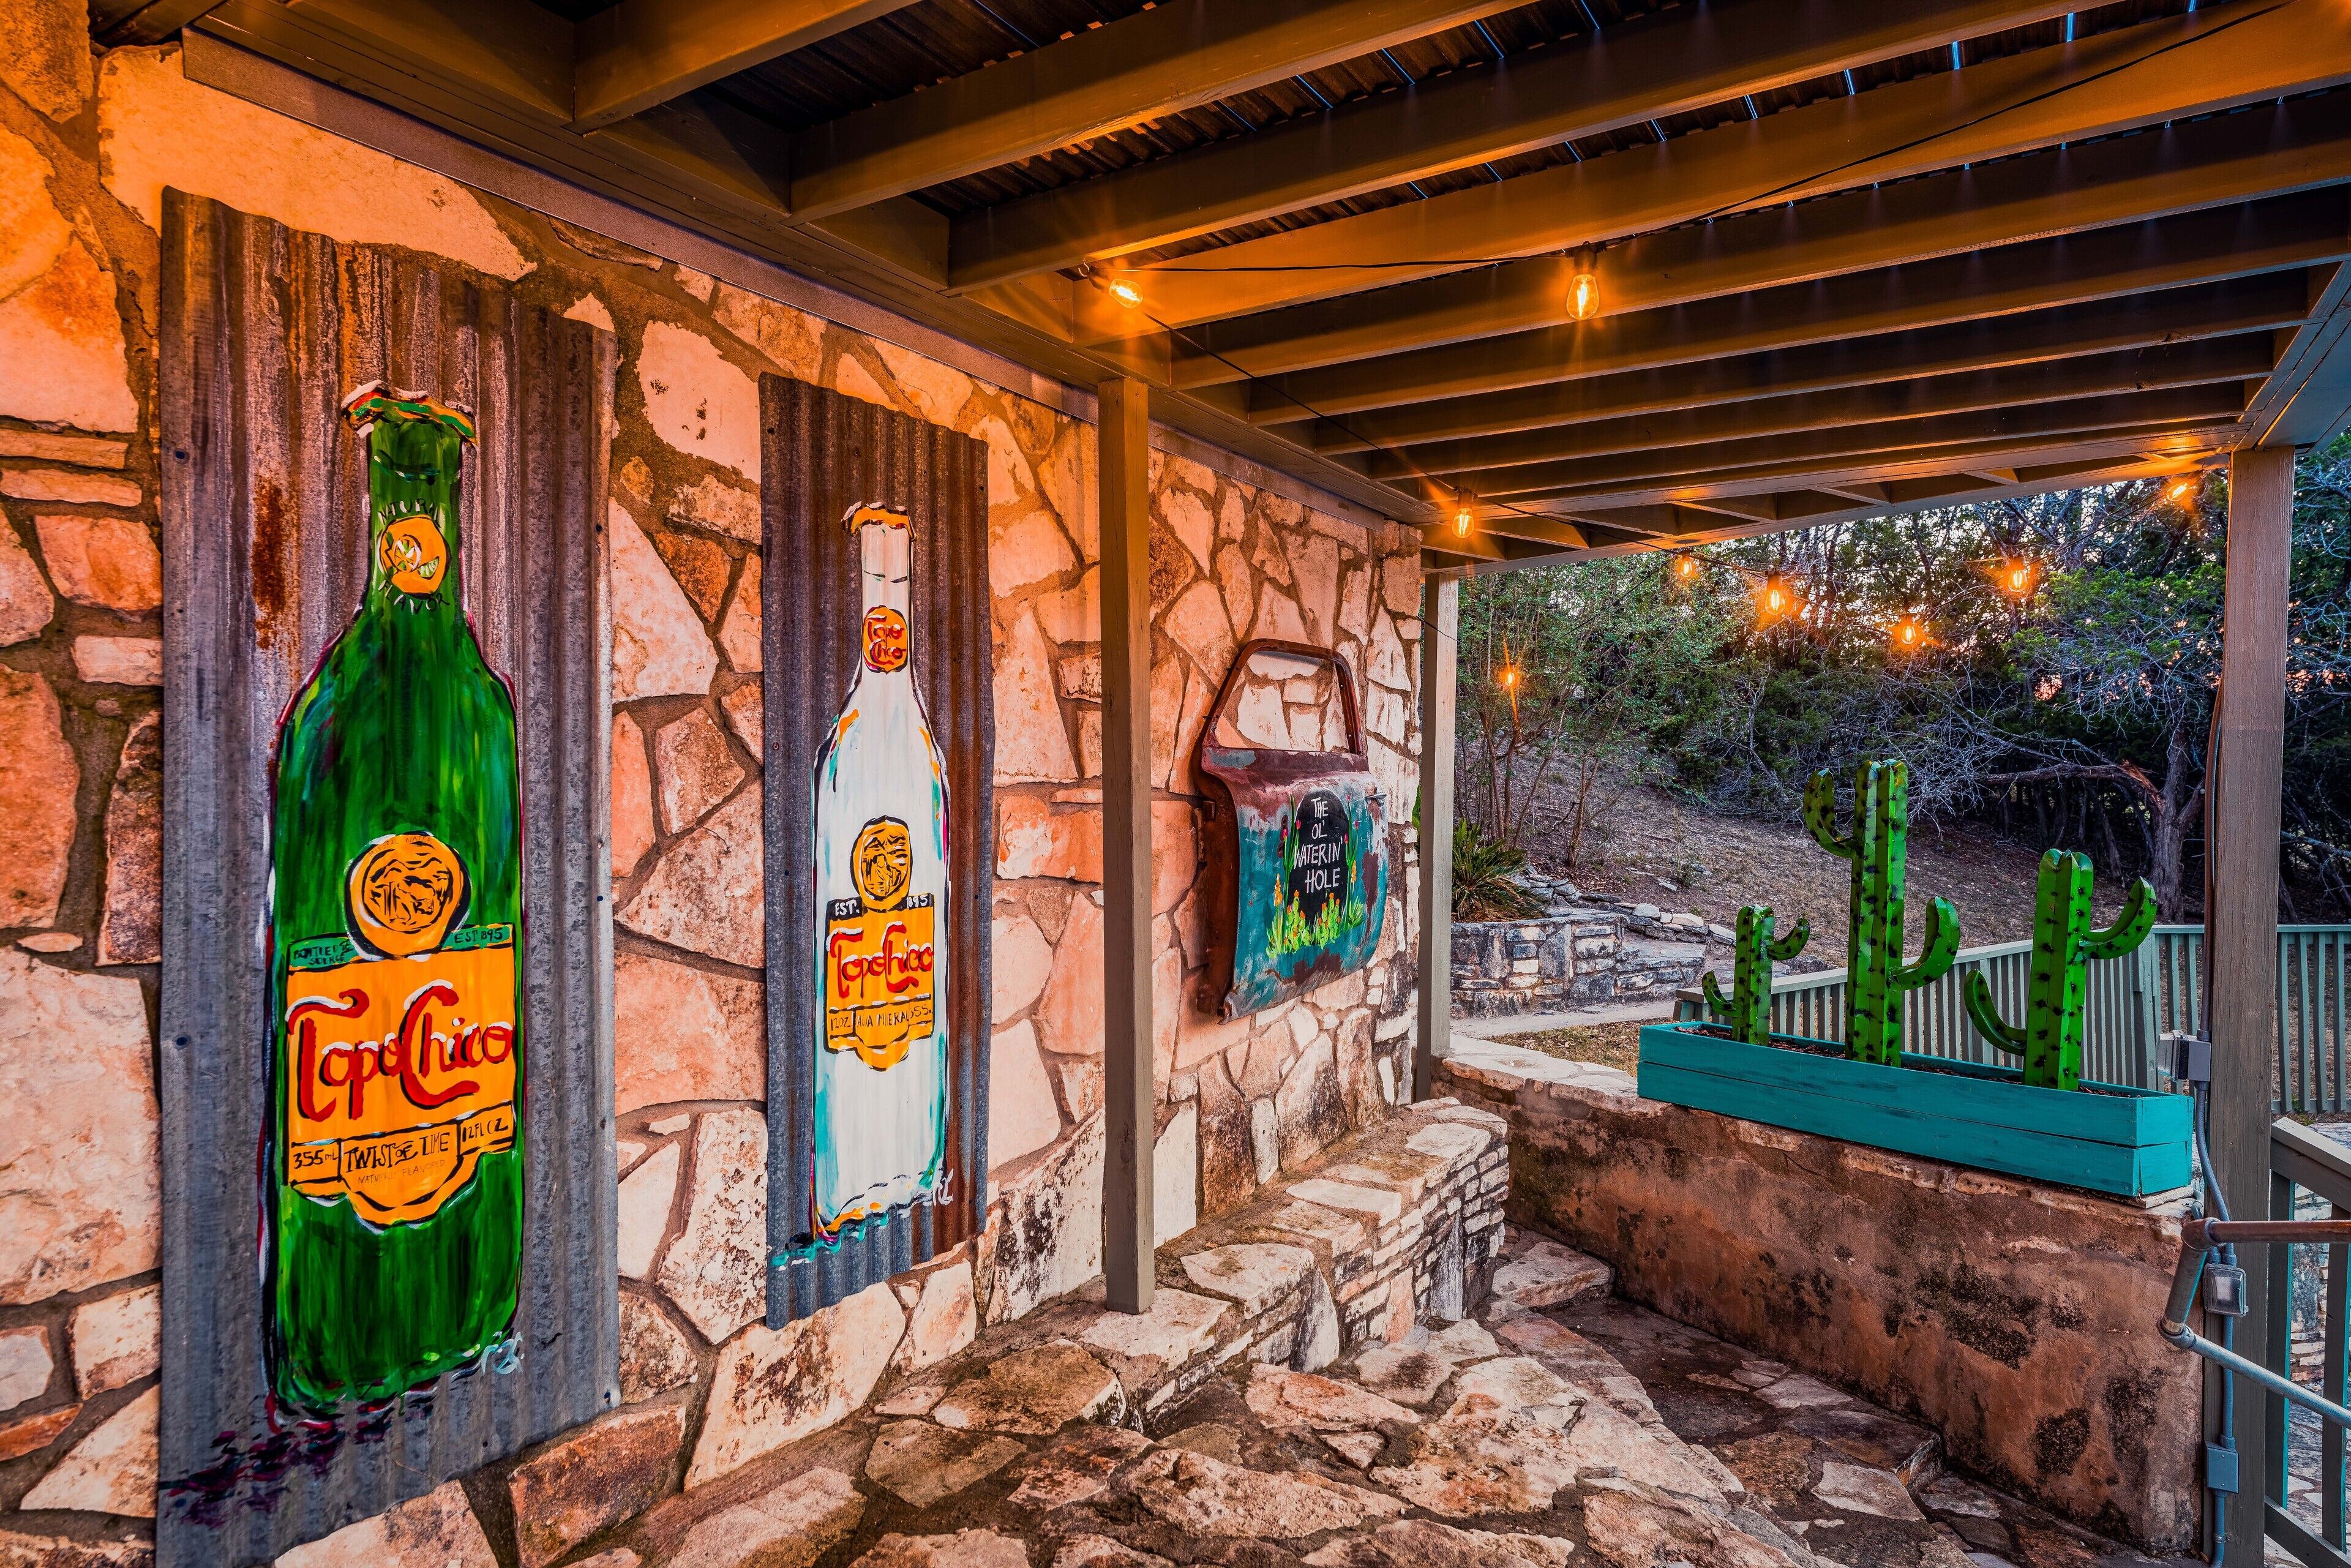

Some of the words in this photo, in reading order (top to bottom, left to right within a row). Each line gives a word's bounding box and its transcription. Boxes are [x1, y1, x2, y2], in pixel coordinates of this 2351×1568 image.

[378, 579, 451, 615] FLAVOR
[867, 614, 905, 649] Topo
[1311, 797, 1329, 819] THE
[405, 834, 433, 843] WATER
[1311, 820, 1327, 839] OL'
[1294, 836, 1343, 869] WATERIN'
[1305, 868, 1341, 893] HOLE
[834, 899, 860, 916] EST.
[454, 930, 478, 943] EST
[827, 927, 885, 999] Topo
[880, 921, 935, 993] Chico
[285, 988, 404, 1122] Topo
[399, 979, 512, 1110] Chico
[344, 1142, 396, 1173] TWIST
[402, 1159, 446, 1176] FLAVORED
